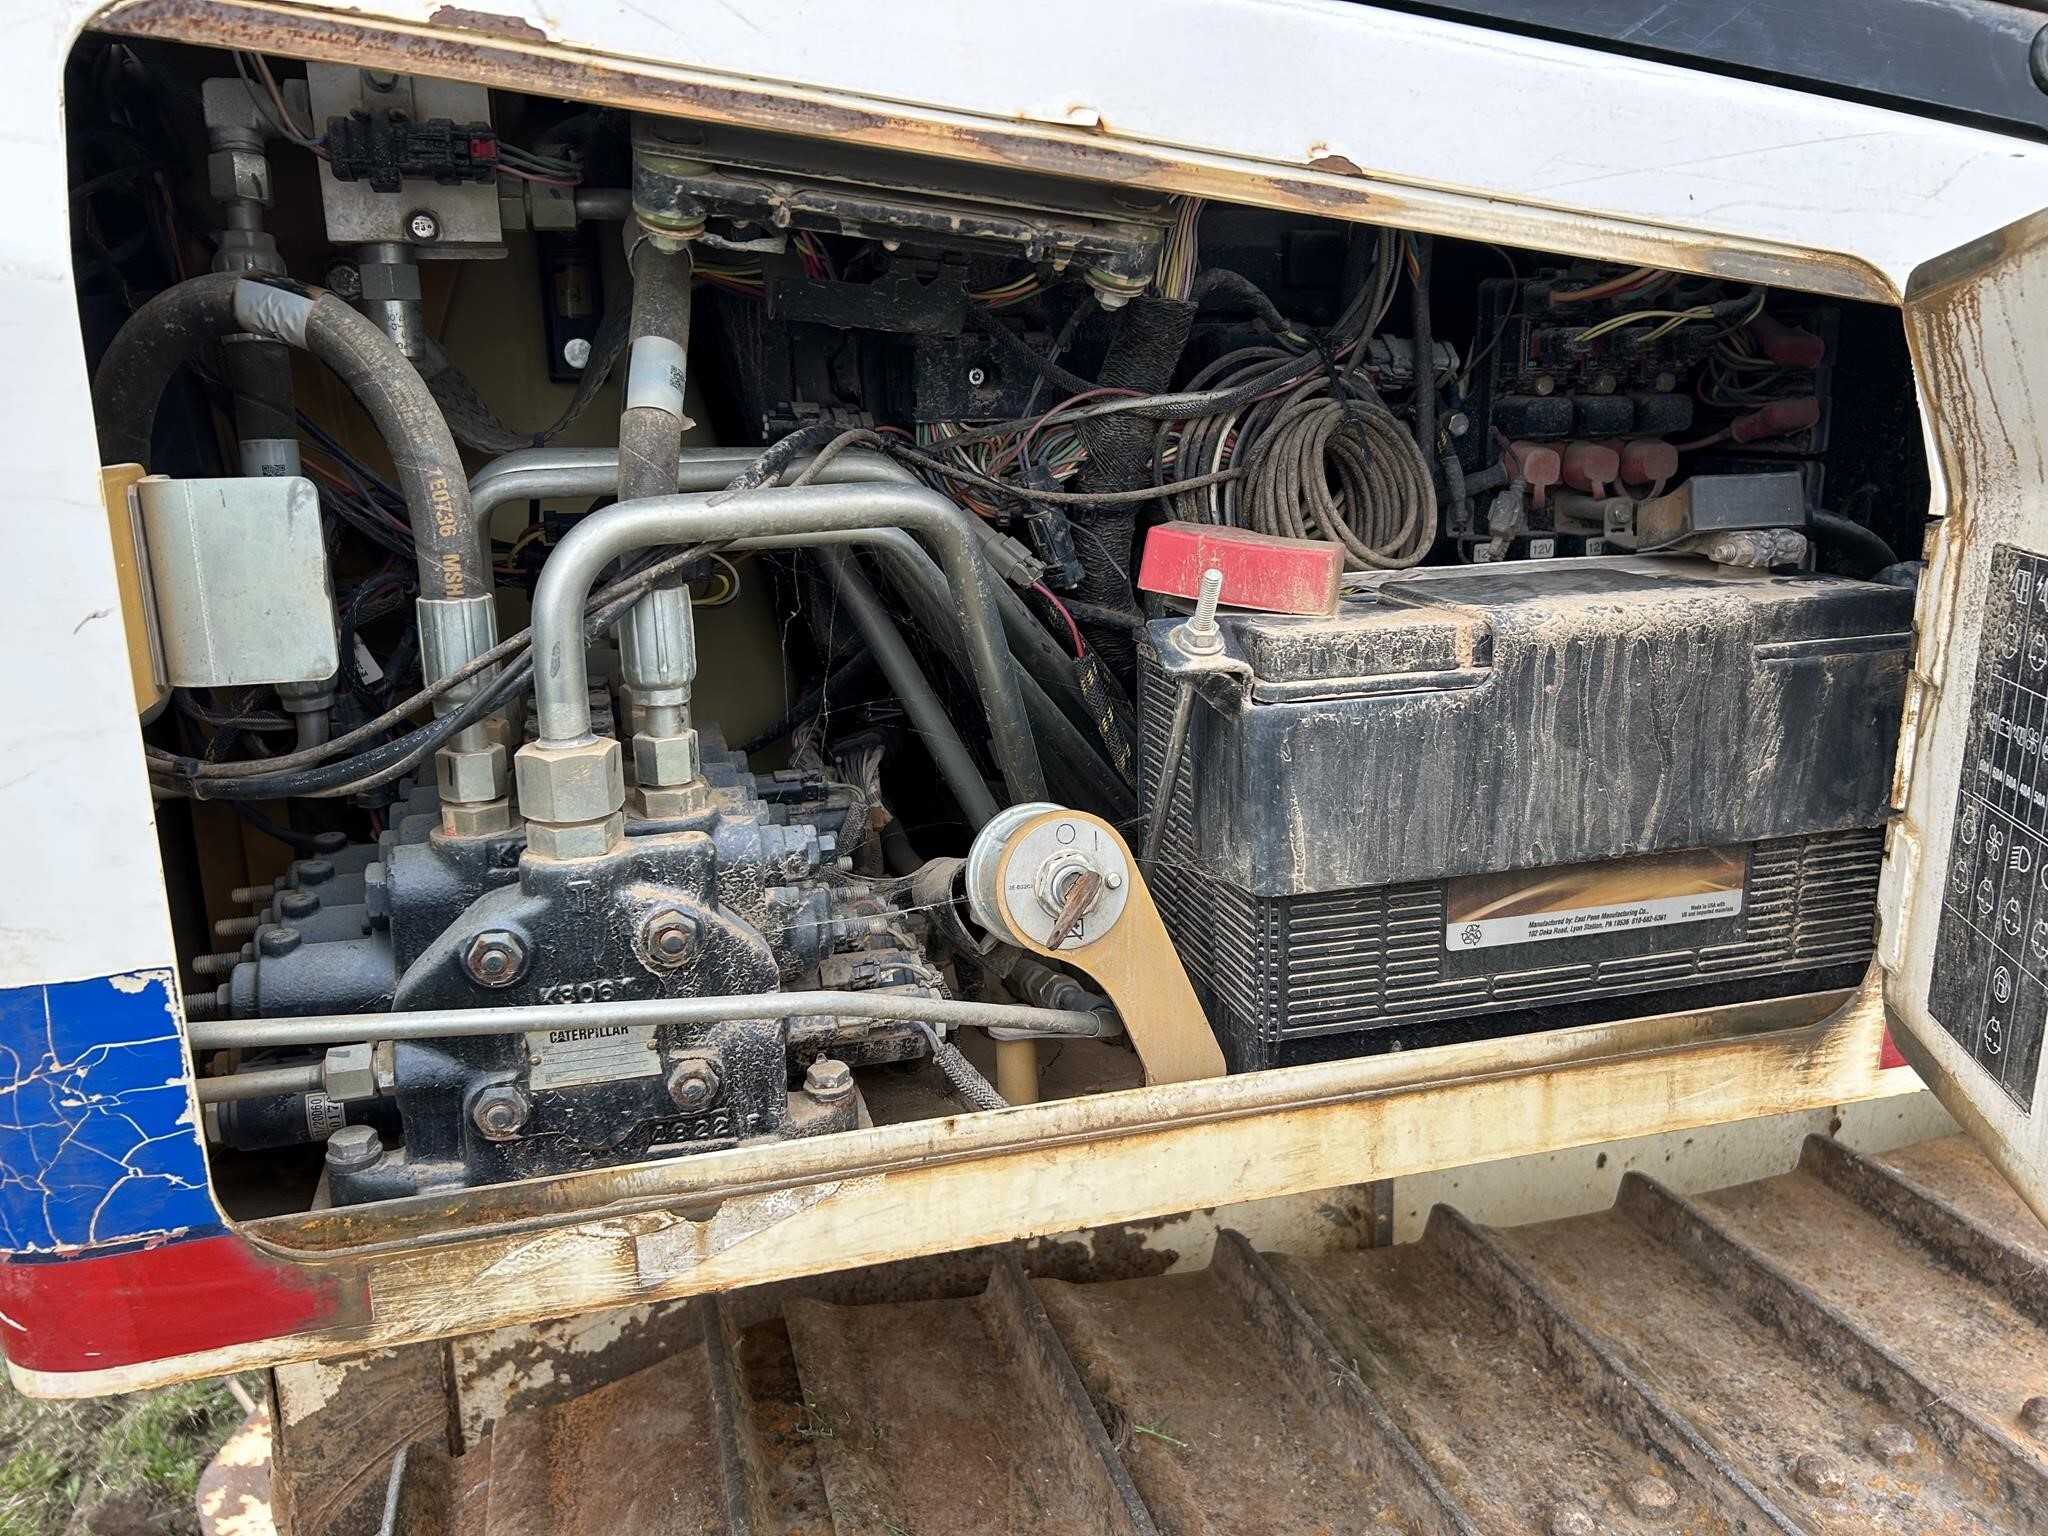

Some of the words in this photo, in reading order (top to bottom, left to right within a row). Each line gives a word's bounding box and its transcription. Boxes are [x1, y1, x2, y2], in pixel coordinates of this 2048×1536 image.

[1532, 543, 1553, 555] 12V
[1586, 914, 1600, 922] Penn
[1601, 908, 1638, 920] Manufacturing
[549, 1025, 630, 1044] CATERPILLAR
